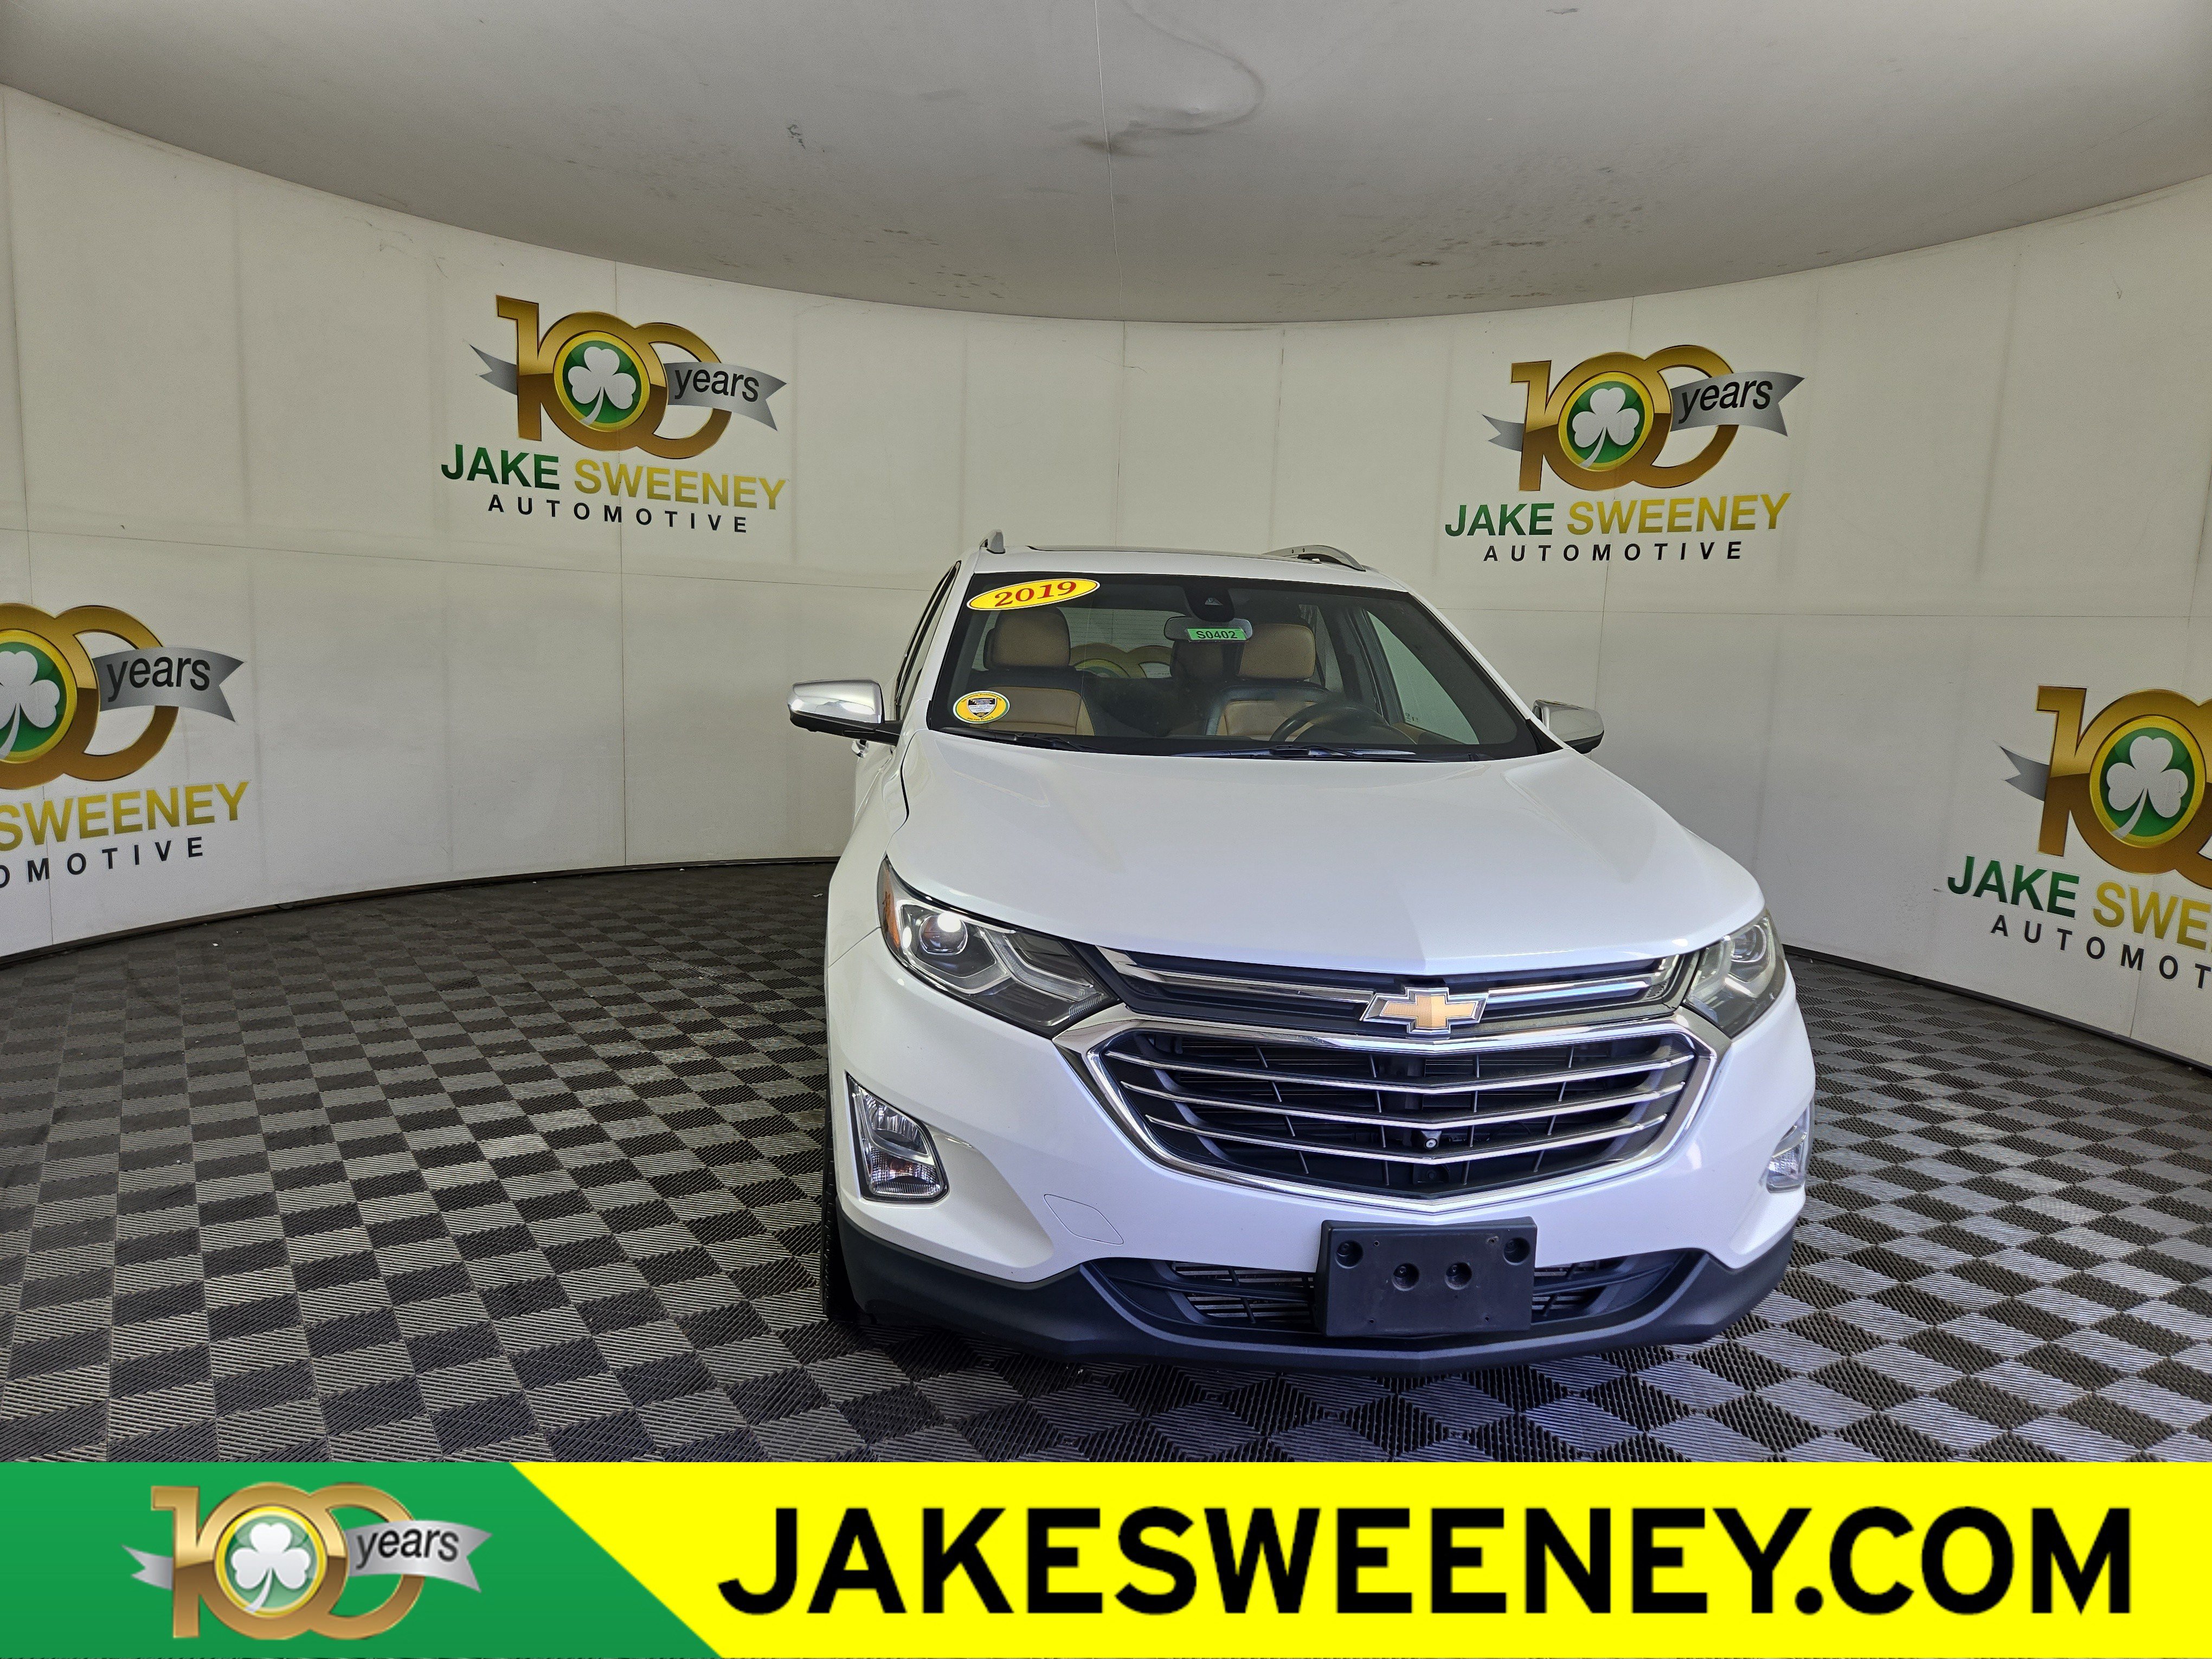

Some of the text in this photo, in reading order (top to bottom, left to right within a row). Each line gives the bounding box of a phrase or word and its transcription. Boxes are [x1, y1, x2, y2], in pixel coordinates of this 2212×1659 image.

[496, 294, 732, 460] 100
[674, 368, 760, 403] years
[1510, 344, 1739, 492] 100
[1677, 380, 1773, 425] years
[441, 444, 787, 510] JAKE SWEENEY
[487, 494, 747, 533] AUTOMOTIVE
[1444, 493, 1791, 537] JAKE SWEENEY
[1483, 541, 1742, 562] AUTOMOTIVE
[994, 581, 1077, 607] 2019
[1195, 631, 1238, 639] S0402
[106, 657, 211, 703] years
[2036, 685, 2212, 890] 10
[1947, 855, 2212, 953] JAKE SWE
[1990, 914, 2212, 989] AUTOMOT
